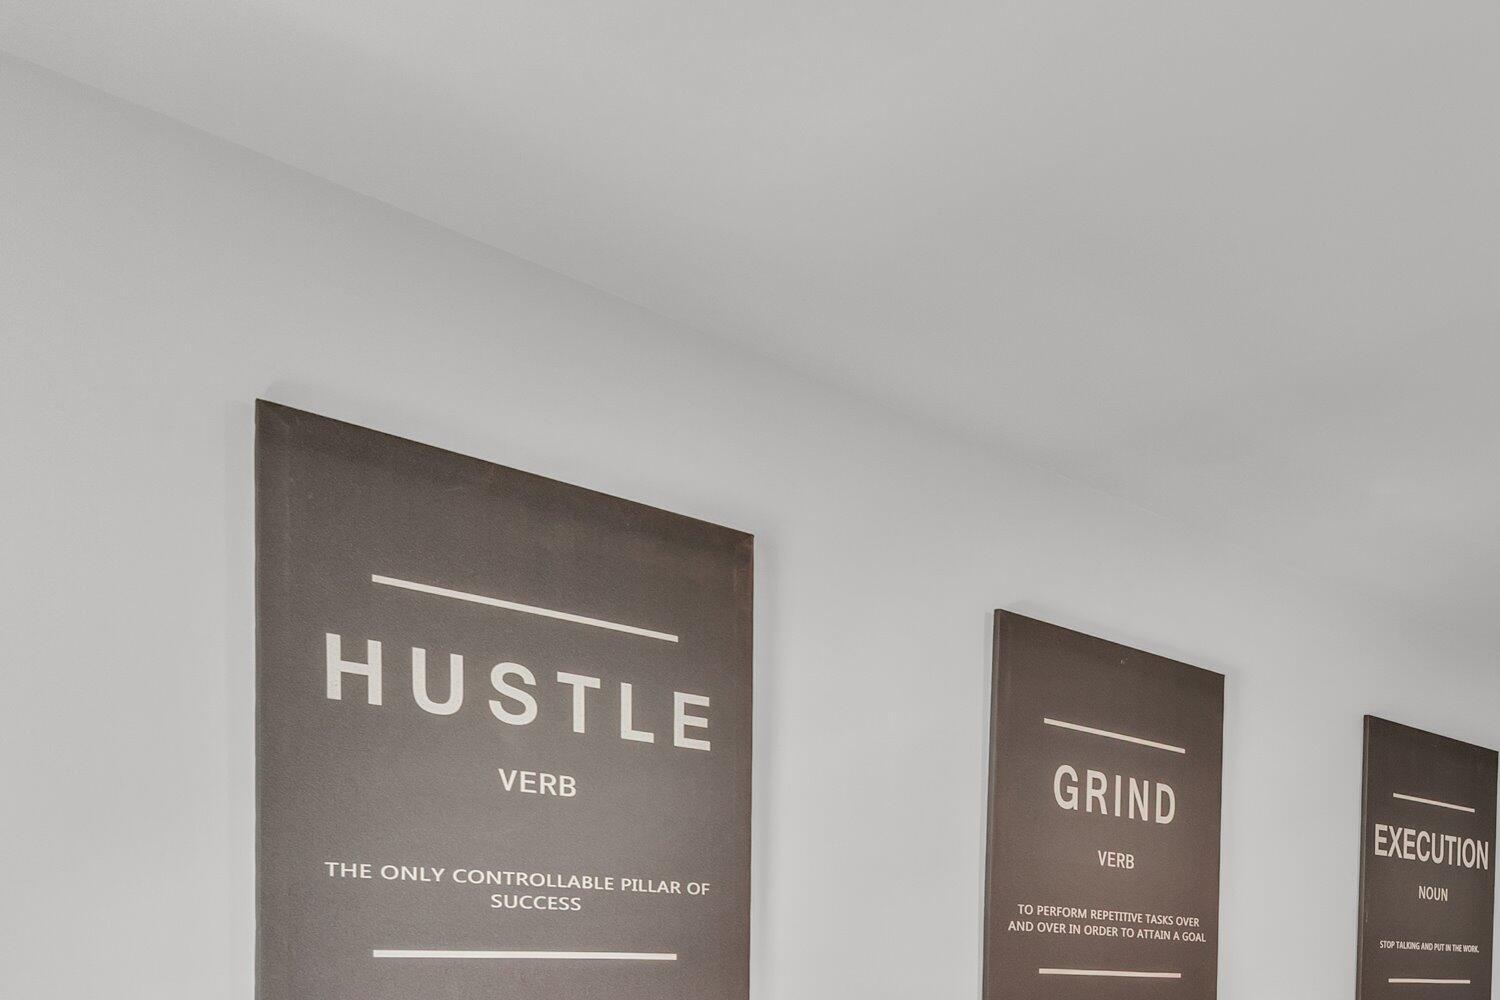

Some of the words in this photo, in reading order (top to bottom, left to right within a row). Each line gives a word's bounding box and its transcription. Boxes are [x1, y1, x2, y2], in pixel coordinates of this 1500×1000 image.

[326, 632, 710, 751] HUSTLE
[499, 769, 576, 797] VERB
[1054, 765, 1175, 824] GRIND
[1375, 824, 1488, 869] EXECUTION
[1098, 850, 1134, 869] VERB
[325, 862, 372, 878] THE
[381, 865, 445, 881] ONLY
[453, 869, 613, 890] CONTROLLABLE
[622, 878, 681, 894] PILLAR
[687, 883, 710, 895] OF
[491, 894, 581, 910] SUCCESS
[1419, 886, 1448, 901] NOUN
[1018, 904, 1033, 915] TO
[1037, 906, 1087, 918] PERFORM
[1091, 910, 1142, 922] REPETITIVE
[1145, 914, 1173, 925] TASKS
[1176, 917, 1199, 927] OVER
[1008, 921, 1033, 931] AND
[1037, 922, 1066, 933] OVER
[1069, 924, 1080, 934] IN
[1084, 925, 1118, 936] ORDER
[1121, 928, 1134, 937] TO
[1137, 929, 1170, 939] ATTAIN
[1173, 932, 1179, 940] A
[1182, 932, 1206, 942] GOAL
[1396, 941, 1420, 949] TALKING
[1434, 943, 1445, 951] PUT
[1452, 944, 1462, 952] THE
[1463, 945, 1479, 953] WORK.
